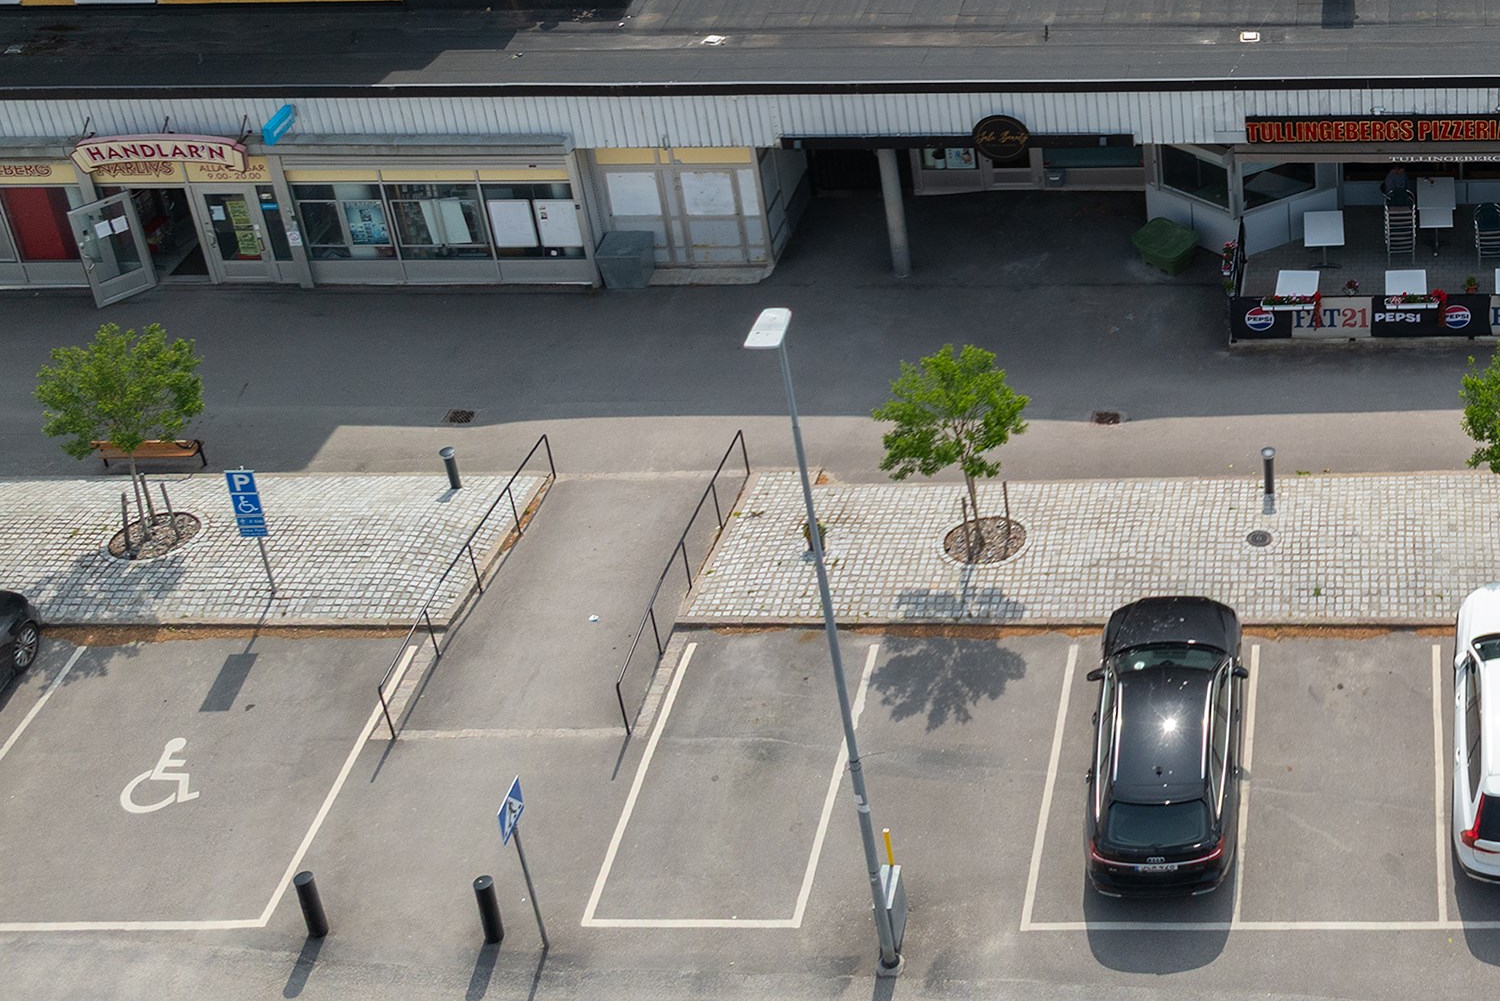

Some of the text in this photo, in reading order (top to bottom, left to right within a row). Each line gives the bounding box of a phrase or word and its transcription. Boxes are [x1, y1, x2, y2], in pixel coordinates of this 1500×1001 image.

[1247, 120, 1414, 143] TULLINGEBERGS
[86, 144, 225, 161] HANDLAR'N
[0, 165, 51, 177] BERG
[1374, 312, 1421, 322] PEPSI
[232, 474, 250, 491] P
